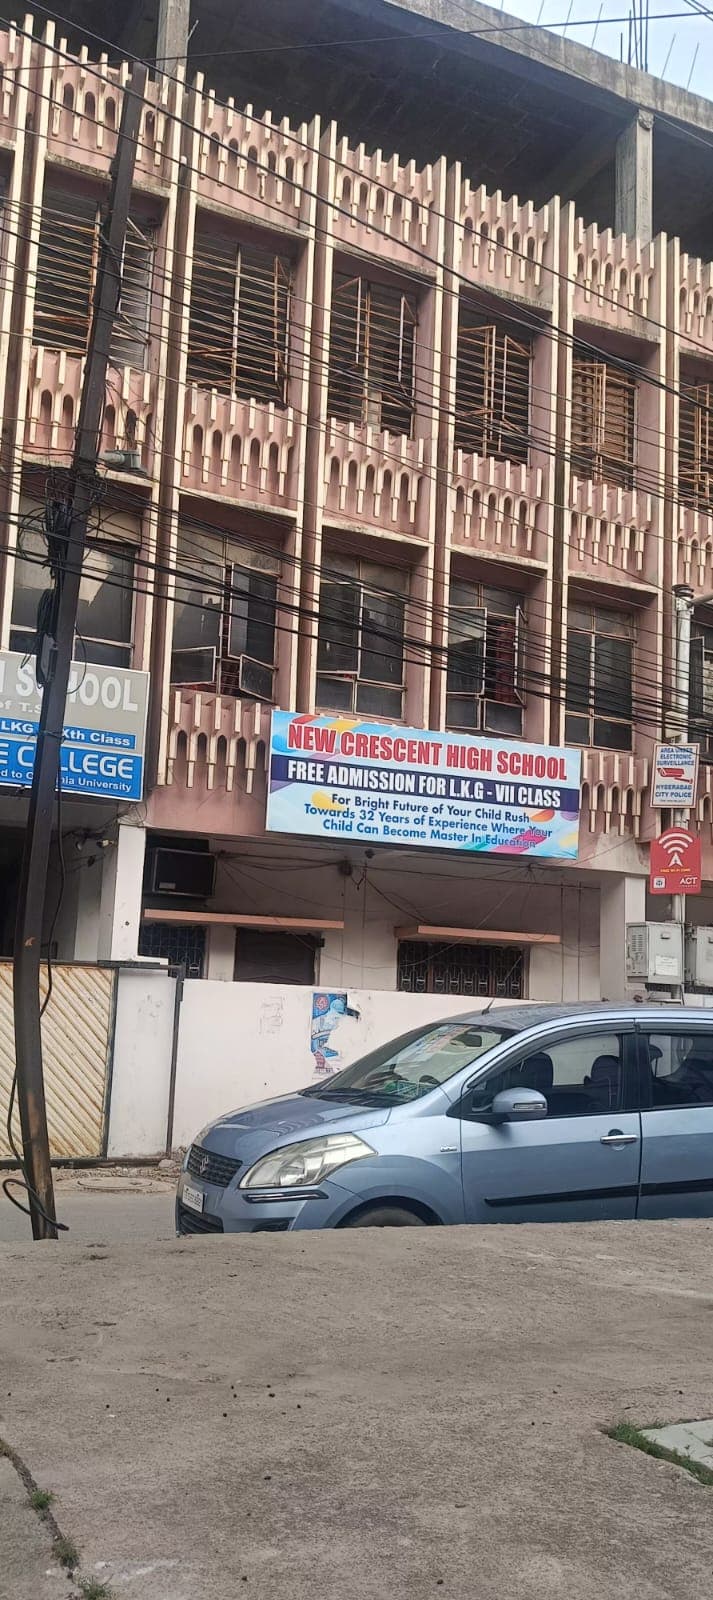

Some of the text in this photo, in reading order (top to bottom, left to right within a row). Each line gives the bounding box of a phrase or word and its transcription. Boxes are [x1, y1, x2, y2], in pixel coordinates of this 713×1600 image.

[1, 720, 34, 734] LKG
[90, 732, 130, 746] Class
[18, 746, 134, 779] CLEGE
[288, 724, 568, 780] NEW CRESCENT HIGH SCHOOL
[12, 770, 22, 778] to
[78, 778, 132, 792] University
[288, 760, 324, 782] FREE
[326, 765, 416, 793] ADMISSION
[418, 776, 446, 796] FOR
[449, 779, 484, 800] L.K.G
[496, 784, 515, 804] VII
[518, 787, 561, 808] CLASS
[304, 804, 552, 837] Towards 32 Years of Experience Where Your
[332, 794, 530, 823] For Bright Future of Your Child Rush
[323, 819, 536, 848] Child Can Become Master In Education
